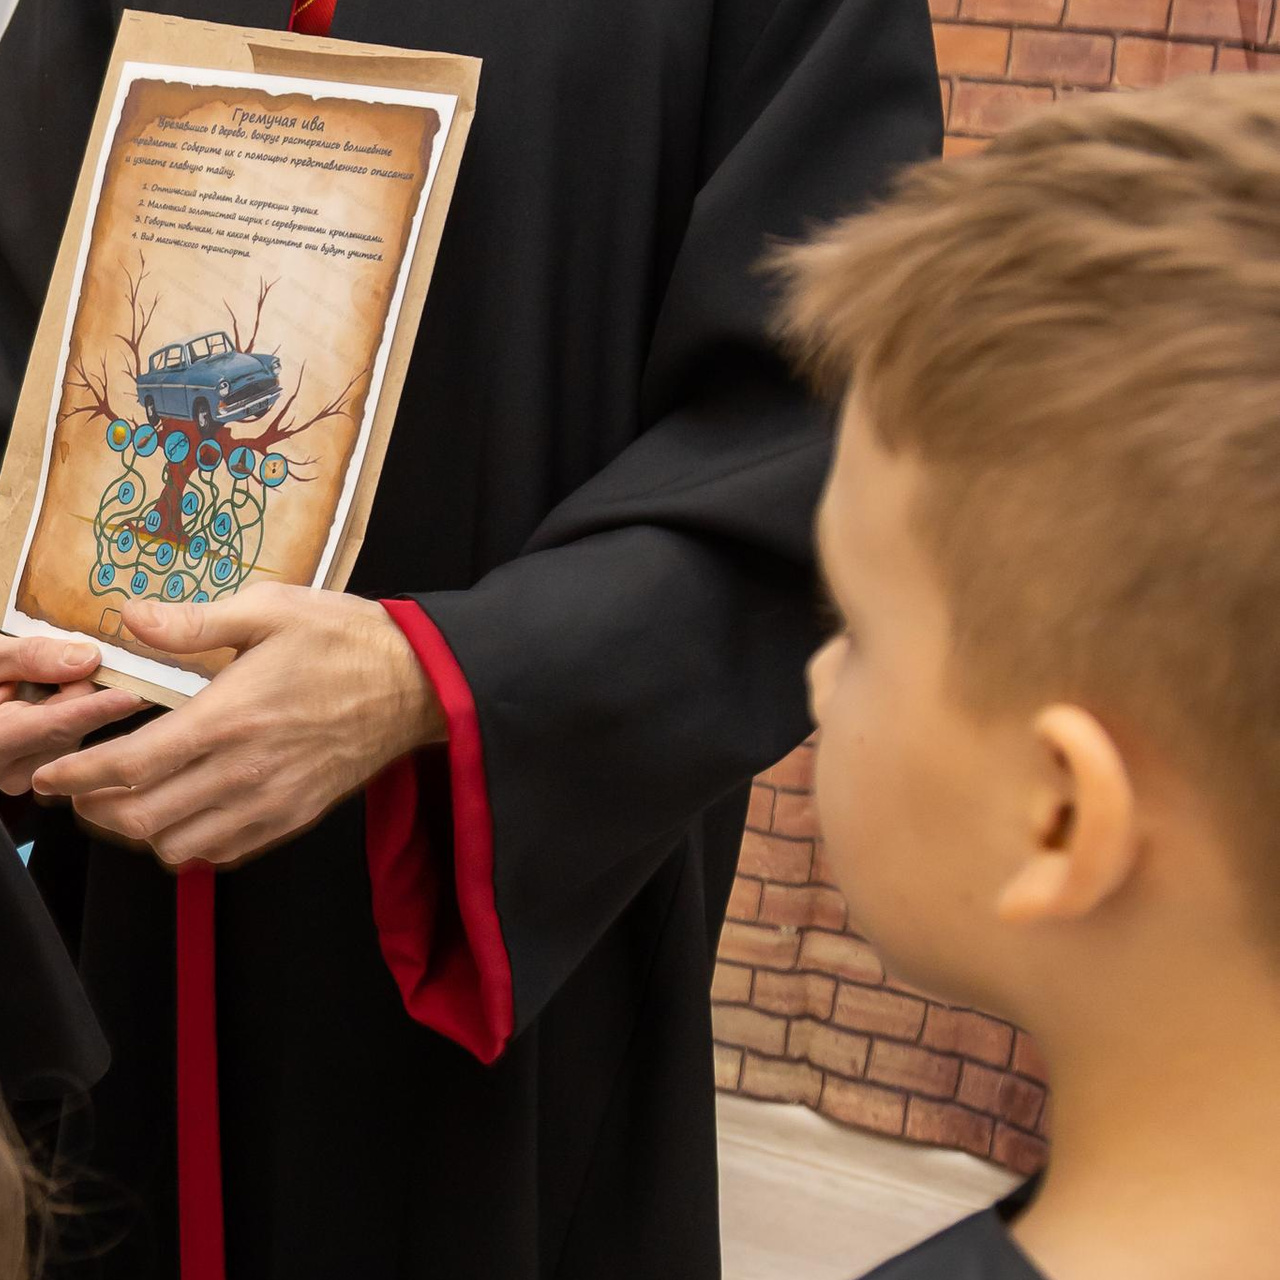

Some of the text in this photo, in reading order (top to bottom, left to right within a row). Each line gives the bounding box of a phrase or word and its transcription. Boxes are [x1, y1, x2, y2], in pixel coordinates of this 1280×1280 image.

[231, 107, 325, 132] Гремучая ива
[157, 115, 393, 157] Врезавшись в дерево, вокруг растерялись волшебные
[133, 156, 166, 168] узнаете
[169, 159, 203, 174] главную
[206, 166, 236, 179] тайну.
[181, 141, 222, 156] Соберите
[224, 149, 235, 158] их
[244, 151, 289, 164] помощью
[290, 156, 368, 175] представленного
[370, 166, 415, 181] описания
[151, 183, 197, 197] Оптический
[198, 191, 233, 203] предмет
[234, 194, 248, 205] для
[249, 198, 289, 212] коррекции
[147, 200, 187, 213] Маленький
[188, 208, 236, 221] золотистый
[238, 214, 263, 226] шарик
[140, 231, 155, 241] Вид
[156, 235, 199, 249] магического
[143, 215, 176, 229] Говорит
[215, 228, 225, 236] на
[226, 230, 250, 240] каком
[251, 232, 303, 248] факультете
[304, 243, 319, 251] они
[320, 242, 345, 256] будут
